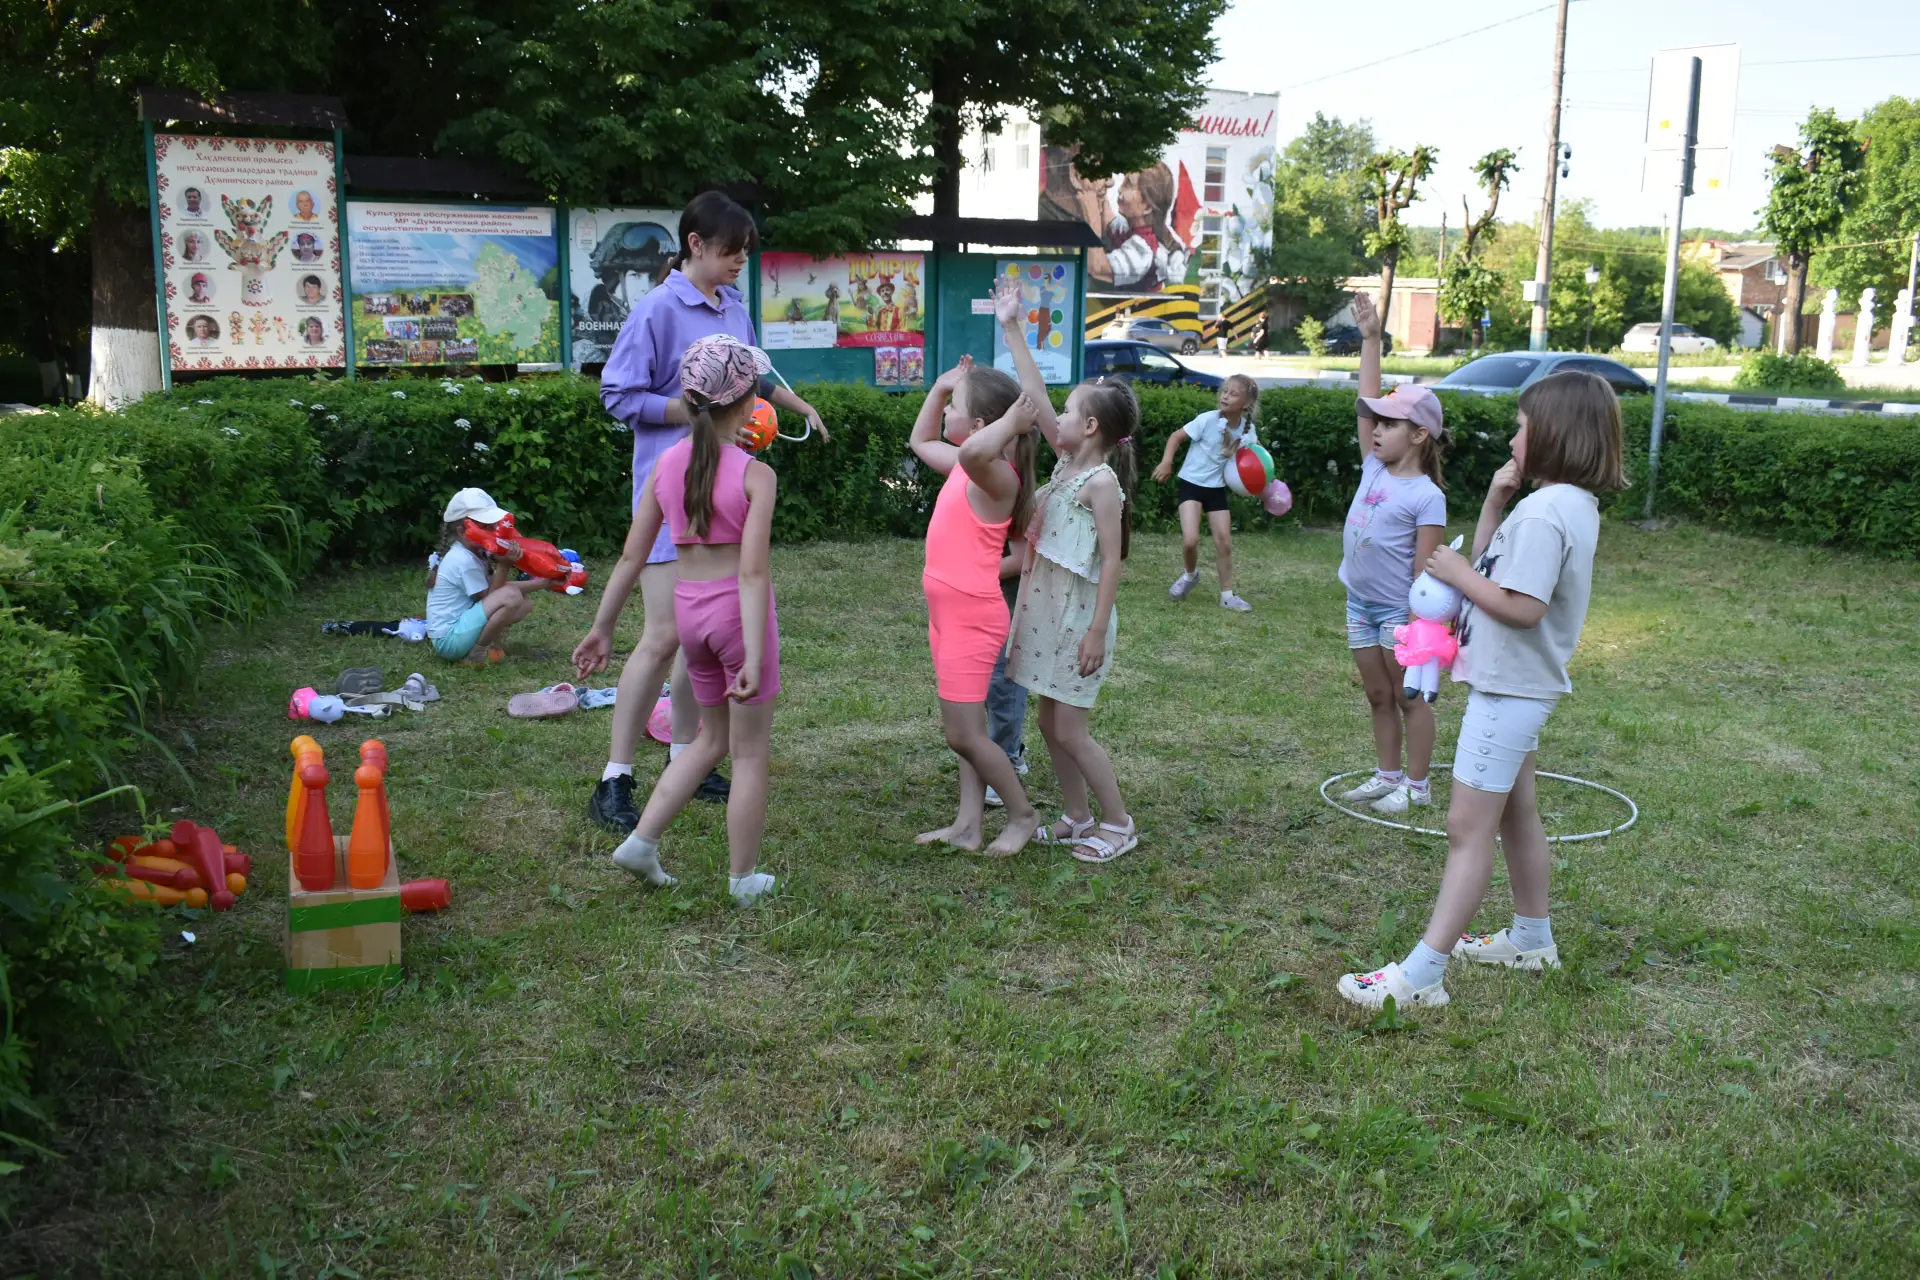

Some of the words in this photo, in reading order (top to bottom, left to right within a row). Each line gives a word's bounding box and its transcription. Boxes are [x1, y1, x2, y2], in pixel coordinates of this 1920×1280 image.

[265, 178, 294, 186] района
[366, 209, 420, 218] Культурное
[423, 210, 490, 220] обслуживание
[362, 225, 429, 233] осуществляет
[444, 226, 499, 235] учреждений
[501, 228, 543, 236] культуры
[849, 259, 920, 285] ЦИРК
